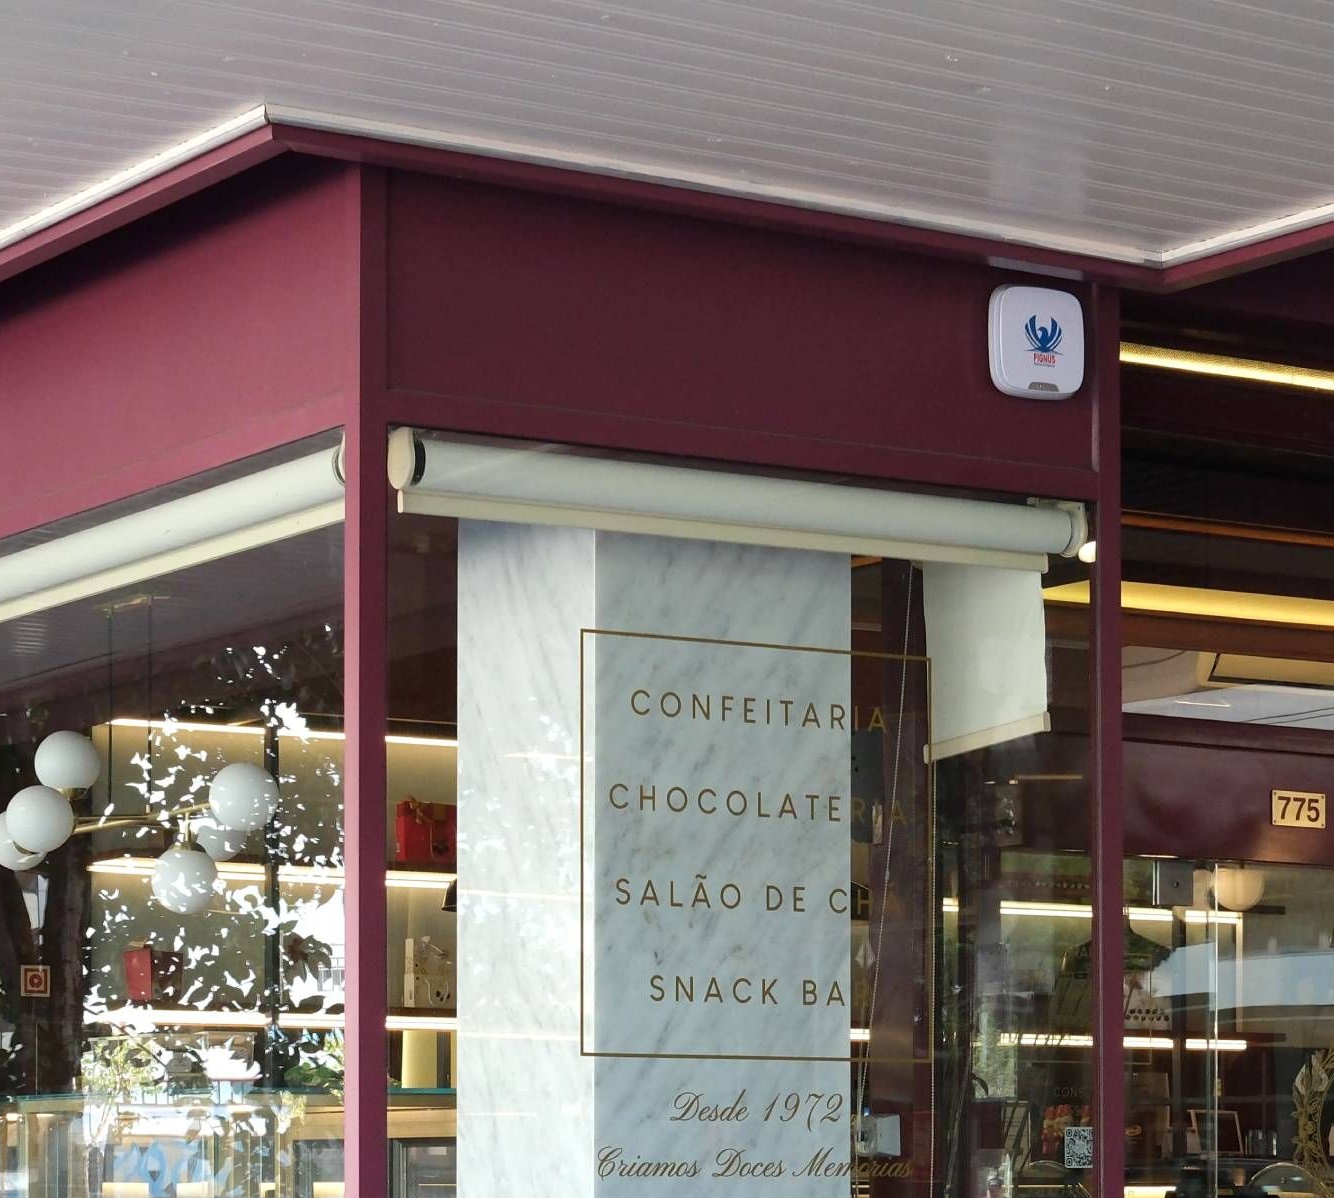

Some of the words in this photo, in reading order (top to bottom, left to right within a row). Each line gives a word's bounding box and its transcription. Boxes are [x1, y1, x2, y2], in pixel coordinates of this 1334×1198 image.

[1033, 352, 1056, 364] PIGNUS
[630, 689, 889, 734] CONFEITARIA
[1277, 796, 1321, 823] 775
[615, 873, 743, 910] SALÃO
[765, 884, 806, 913] DE
[650, 974, 779, 1006] SNACK
[670, 1089, 750, 1124] Desde
[763, 1092, 844, 1132] 1972
[597, 1146, 701, 1179] Criamos
[711, 1149, 785, 1178] Doces
